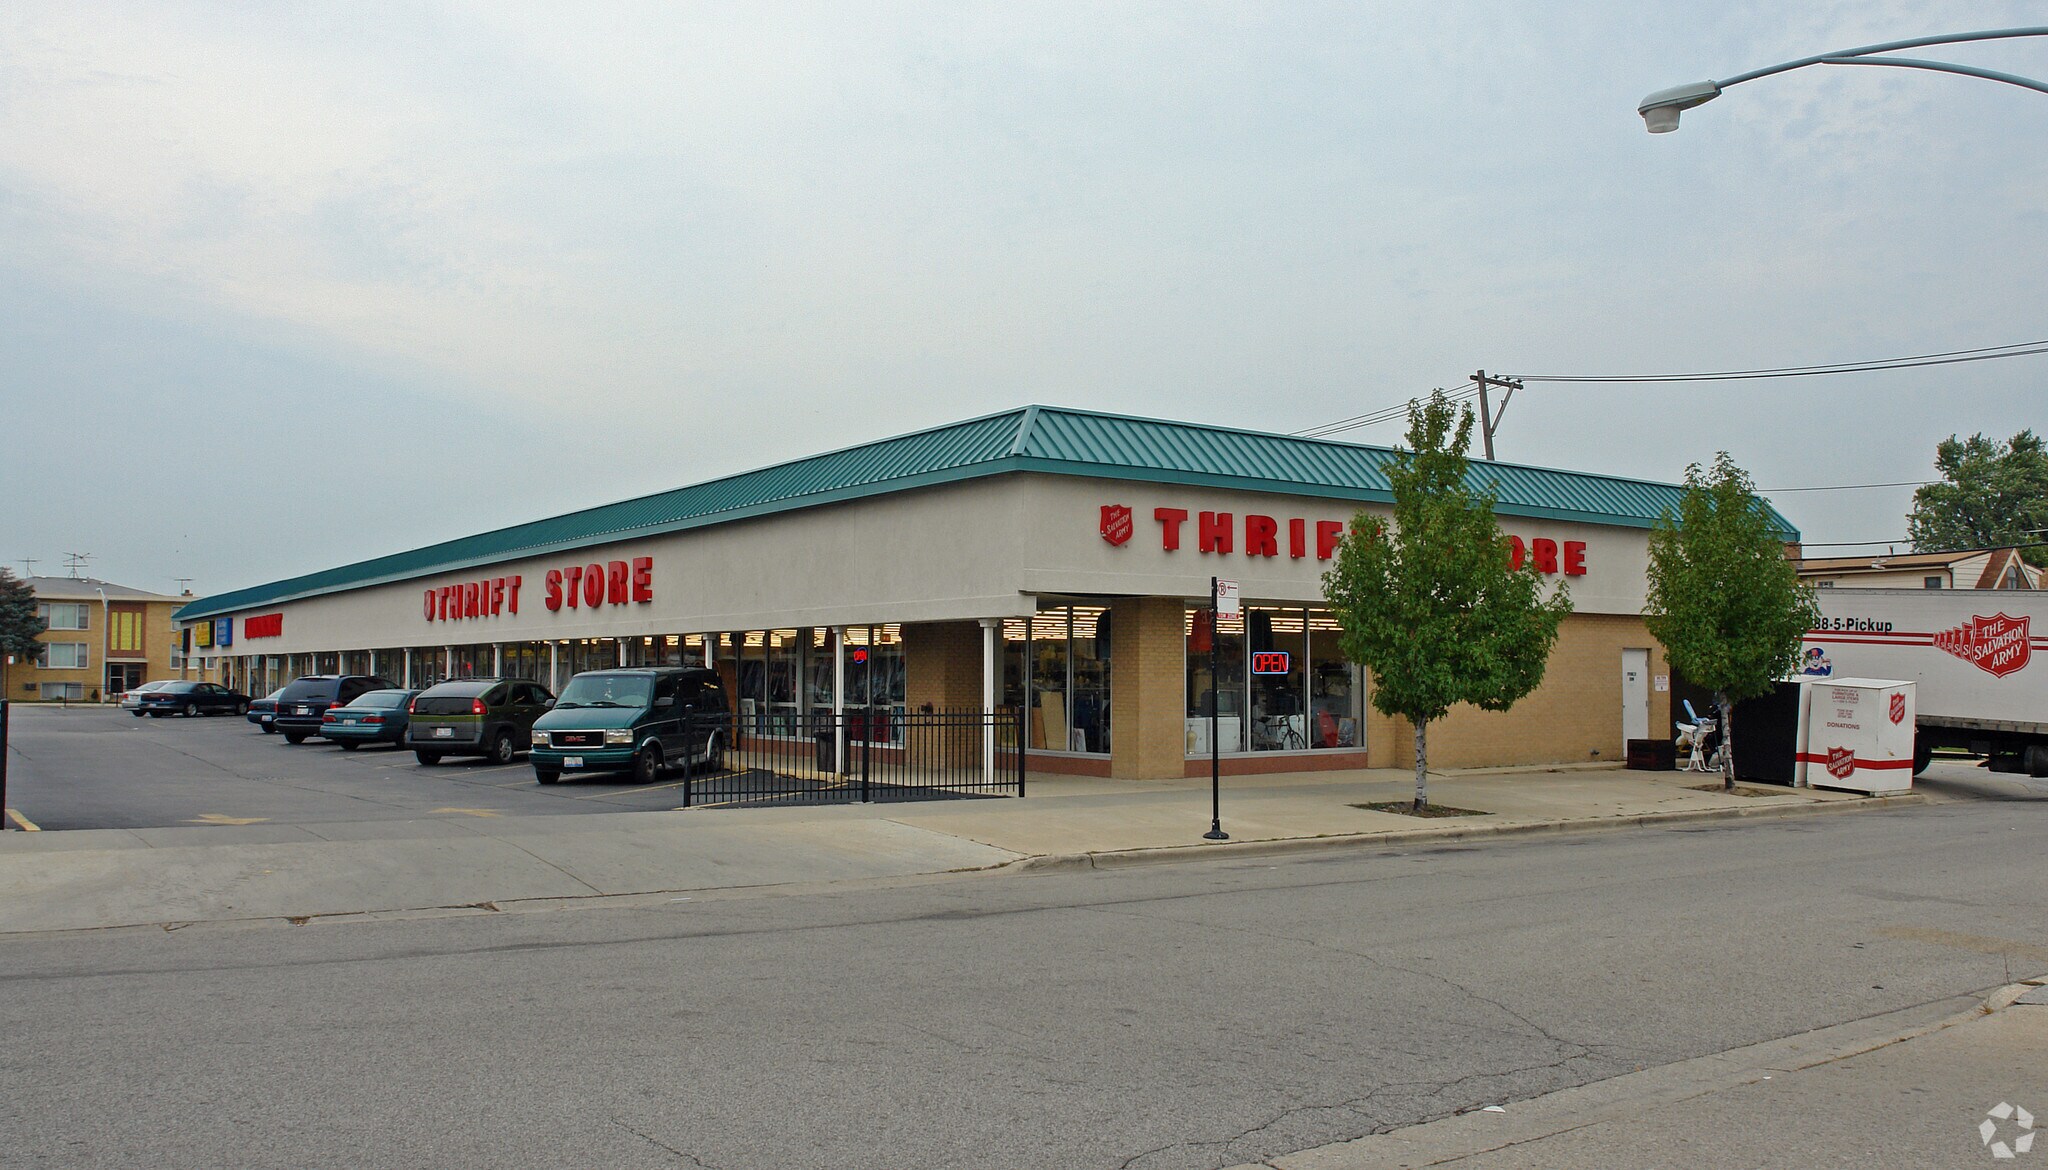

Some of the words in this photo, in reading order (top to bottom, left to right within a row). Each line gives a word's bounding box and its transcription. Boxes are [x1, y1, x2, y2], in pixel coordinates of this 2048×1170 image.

[1106, 512, 1130, 534] SALVATION
[1110, 509, 1120, 521] THE
[1115, 523, 1130, 540] ARMY
[1154, 507, 1382, 562] THRIF
[436, 575, 522, 621] THRIFT
[545, 556, 653, 612] STORE
[1982, 619, 2005, 639] THE
[1974, 622, 2024, 661] SALVATION
[1254, 654, 1287, 672] OPEN
[1991, 640, 2023, 669] ARMY
[1826, 722, 1860, 730] DONATIONS
[1828, 753, 1853, 771] SALVATION
[1832, 751, 1843, 760] THE
[1837, 763, 1851, 776] ARMY
